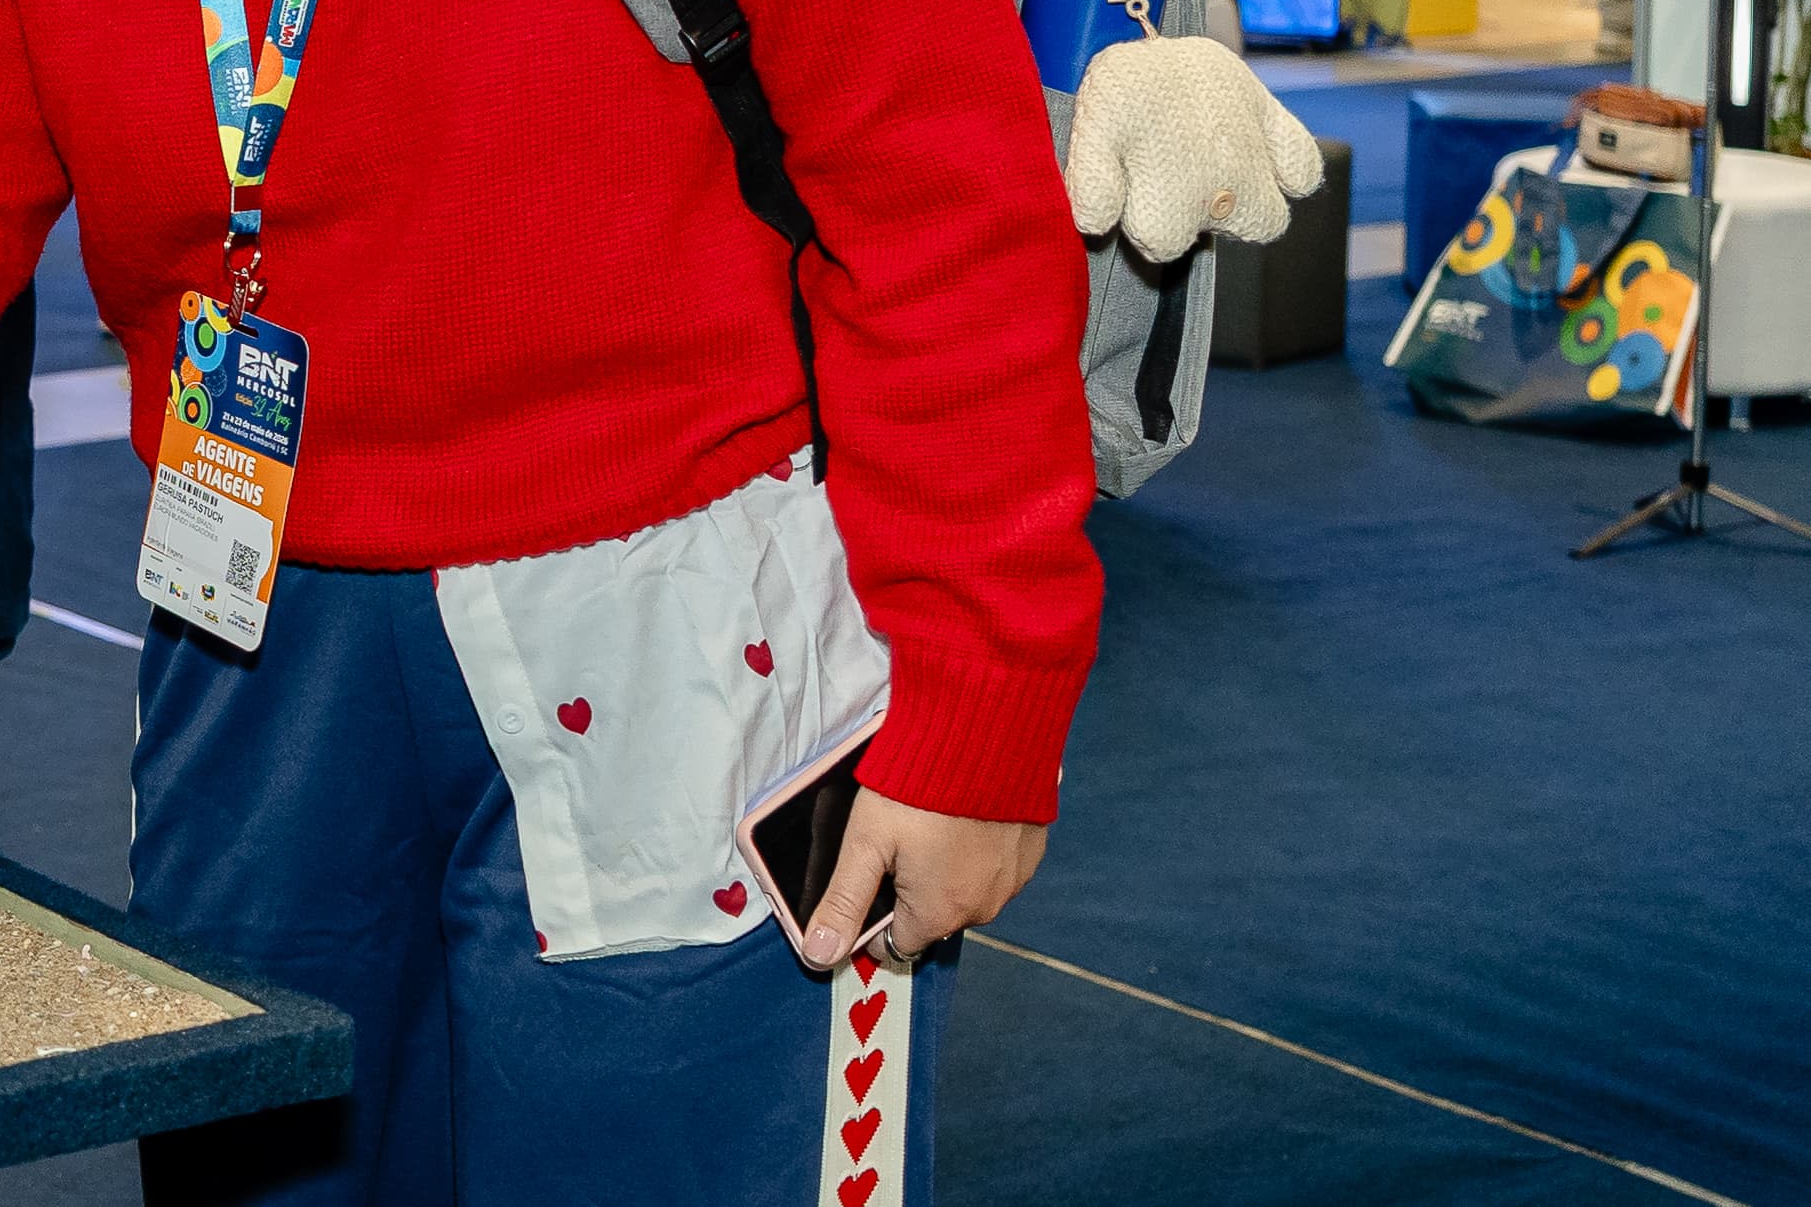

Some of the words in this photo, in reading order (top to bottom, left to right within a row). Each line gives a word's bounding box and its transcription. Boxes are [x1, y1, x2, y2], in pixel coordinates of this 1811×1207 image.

[244, 116, 265, 162] BNT
[238, 343, 299, 391] BNT
[236, 375, 296, 408] MERCOSUL
[193, 435, 257, 478] AGENTE
[157, 481, 187, 506] GERUSA
[188, 497, 224, 525] PASTUCH
[181, 461, 196, 477] DE
[196, 459, 265, 507] VIAGENS
